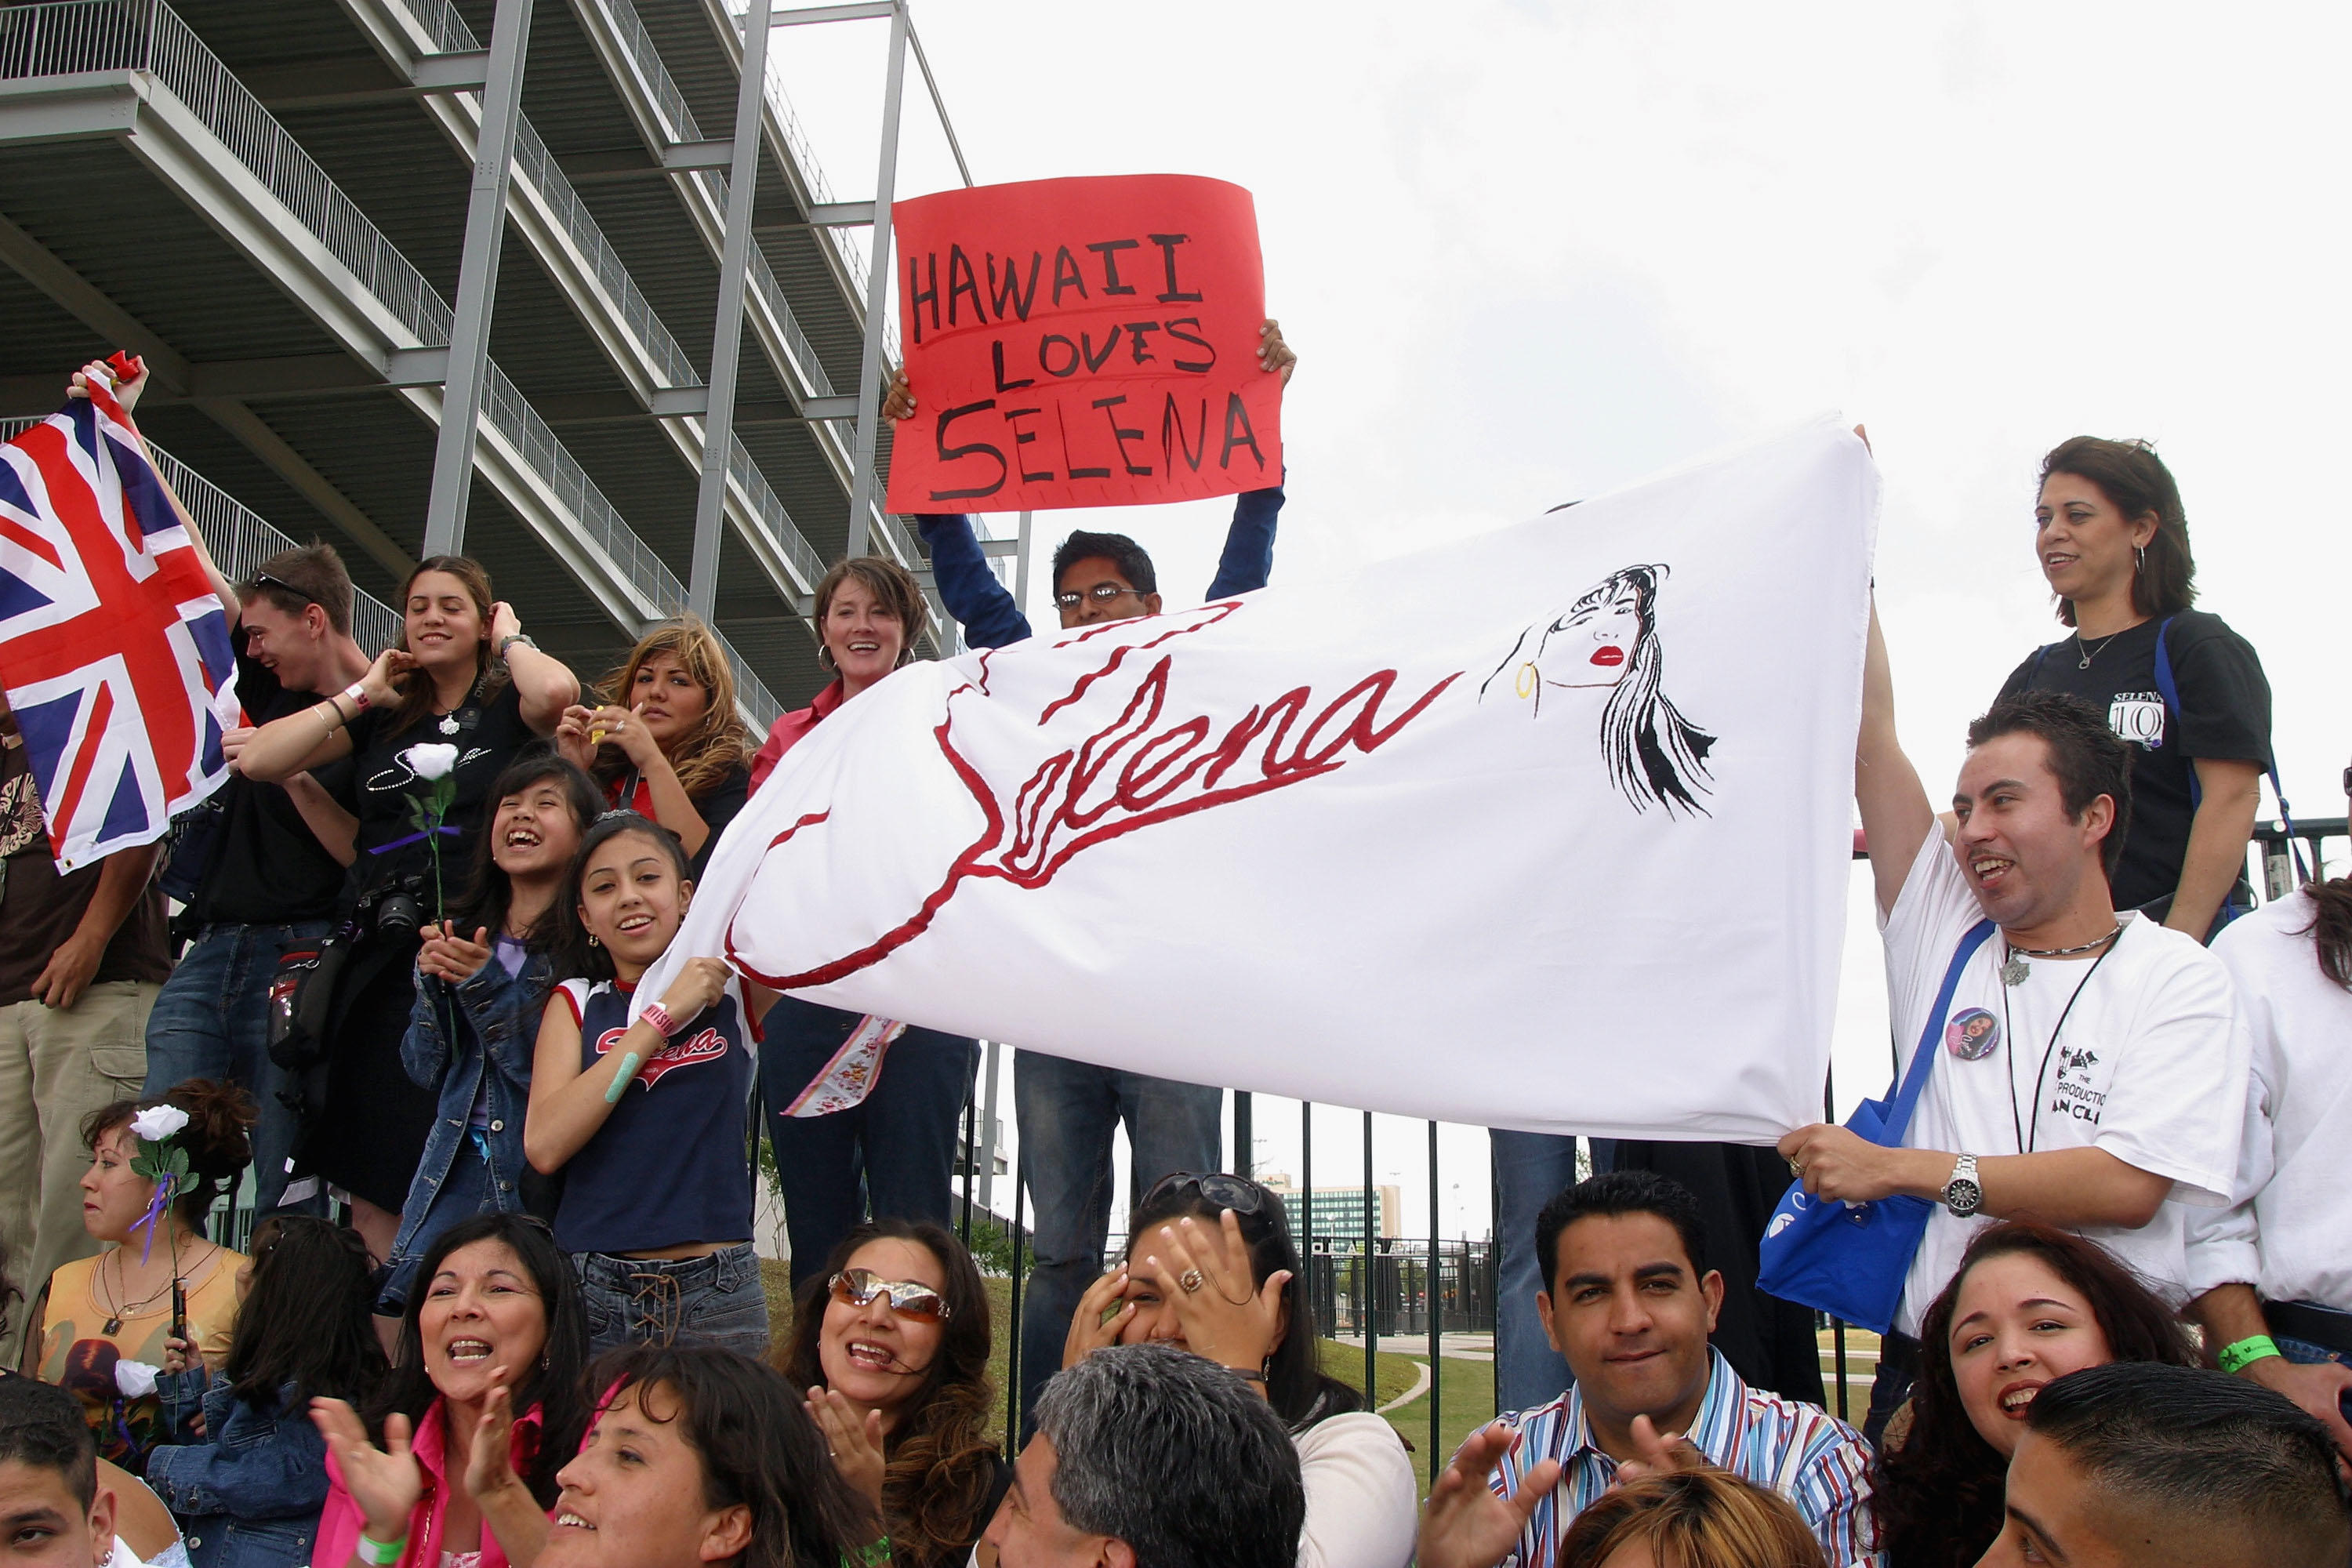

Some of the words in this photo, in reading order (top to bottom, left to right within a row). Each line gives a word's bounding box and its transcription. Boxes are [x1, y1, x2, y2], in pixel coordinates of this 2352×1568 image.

[909, 233, 1203, 344] HAWAII
[992, 317, 1217, 393] LOVES
[928, 391, 1266, 502] SELENA
[2111, 706, 2162, 736] 10
[2114, 691, 2164, 703] SELENA
[2078, 1074, 2092, 1084] THE
